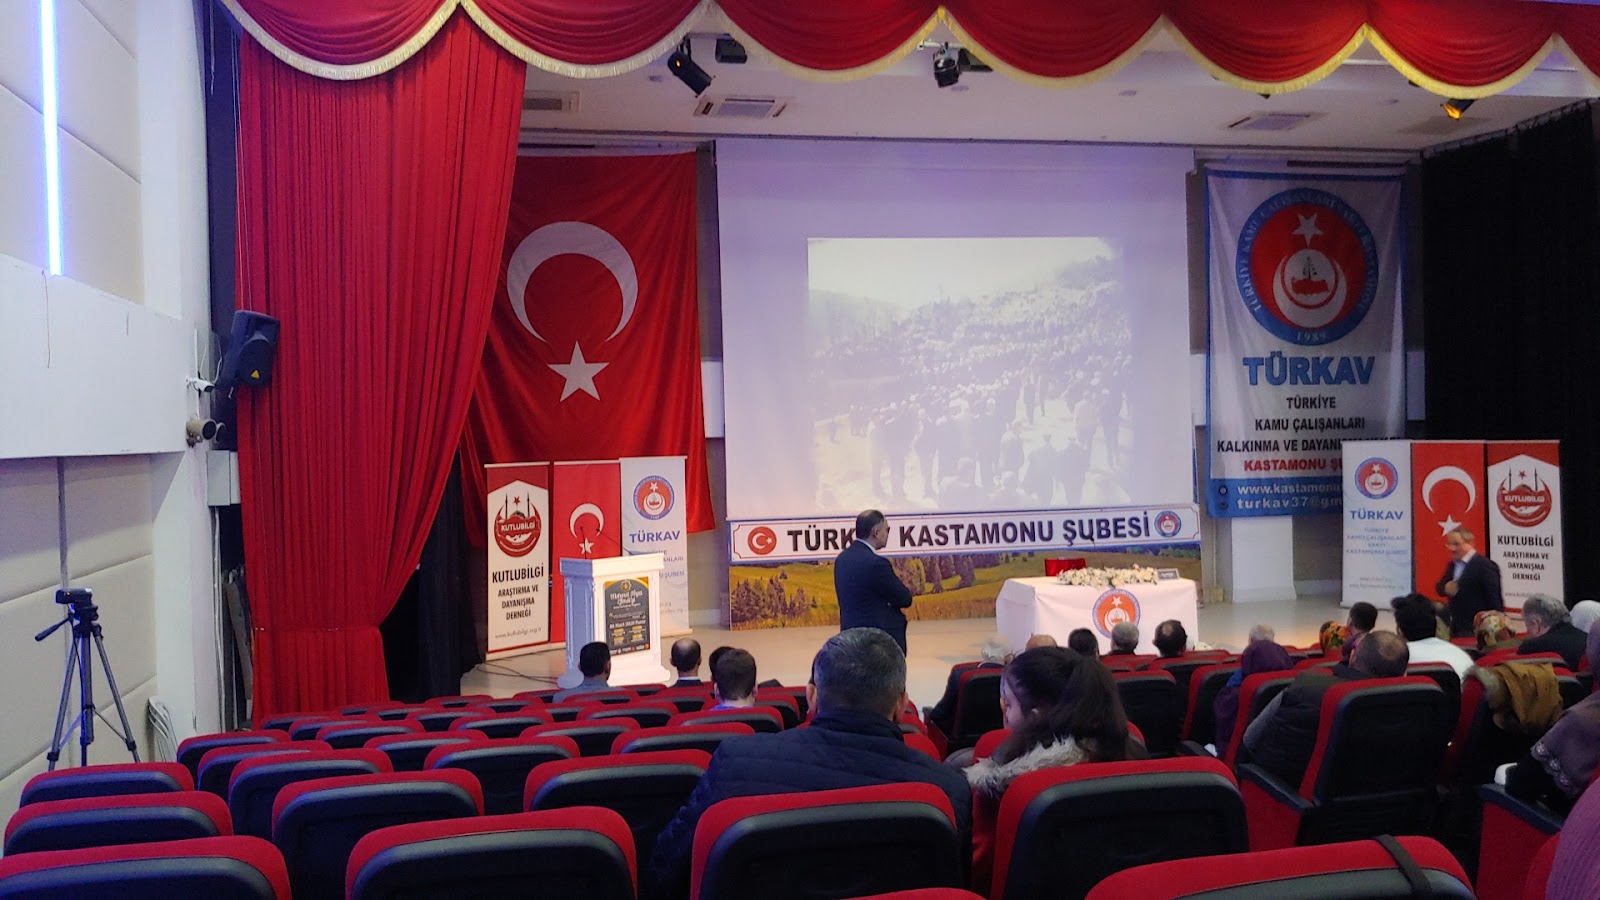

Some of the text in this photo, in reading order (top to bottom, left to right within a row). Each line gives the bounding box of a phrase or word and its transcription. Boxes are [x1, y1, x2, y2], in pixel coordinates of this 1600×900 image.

[1243, 351, 1376, 386] TÜRKAV
[1286, 394, 1336, 409] TÜRKİYE
[1255, 416, 1366, 433] KAMU ÇALIŞANLARI
[1217, 437, 1361, 453] KALKINMA VE DAYANI
[1244, 458, 1327, 472] KASTAMONU
[1237, 483, 1342, 495] www.kastamonu
[1350, 507, 1404, 521] TÜRKAV
[629, 530, 681, 544] TÜRKAV
[787, 524, 856, 552] TÜRK
[900, 520, 1053, 548] KASTAMONU
[1062, 511, 1151, 547] ŞUBESİ
[1497, 533, 1554, 547] KUTLUBİLGİ
[1503, 551, 1550, 561] ARAŞTIRMA VE
[492, 563, 544, 584] KUTLUBİLGİ
[1508, 562, 1545, 571] DAYANIŞMA
[1512, 572, 1541, 581] DERNEĞİ
[498, 584, 539, 598] ARAŞTIRMA VE
[501, 597, 535, 609] DAYANIŞMA
[506, 607, 532, 620] DERNEĞİ
